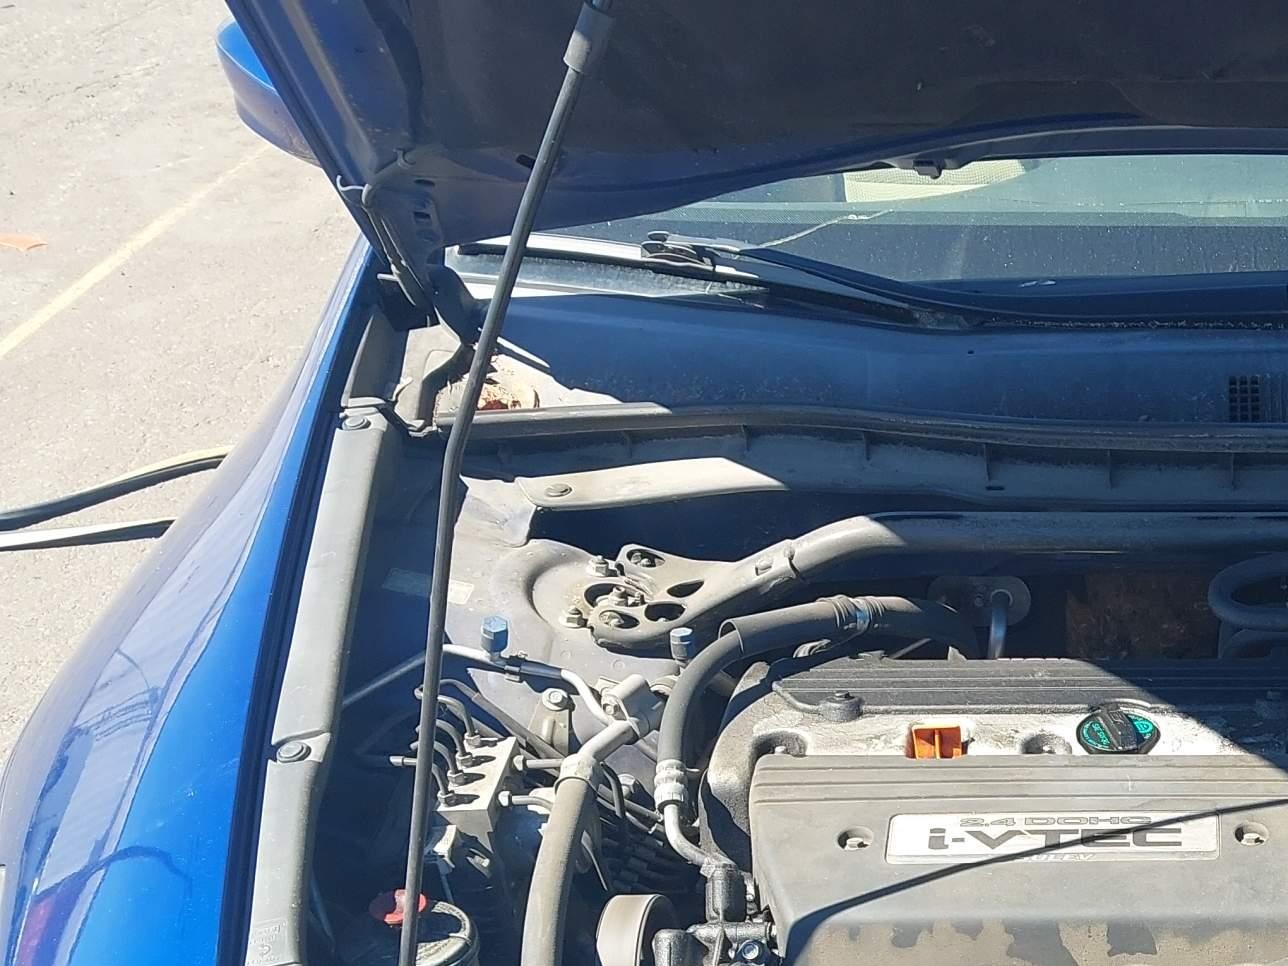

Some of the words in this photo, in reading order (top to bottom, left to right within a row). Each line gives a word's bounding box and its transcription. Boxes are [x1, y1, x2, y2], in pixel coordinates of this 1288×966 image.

[960, 817, 1016, 827] 2.4
[1024, 816, 1152, 826] DOHC
[927, 827, 1183, 850] i-VTEC
